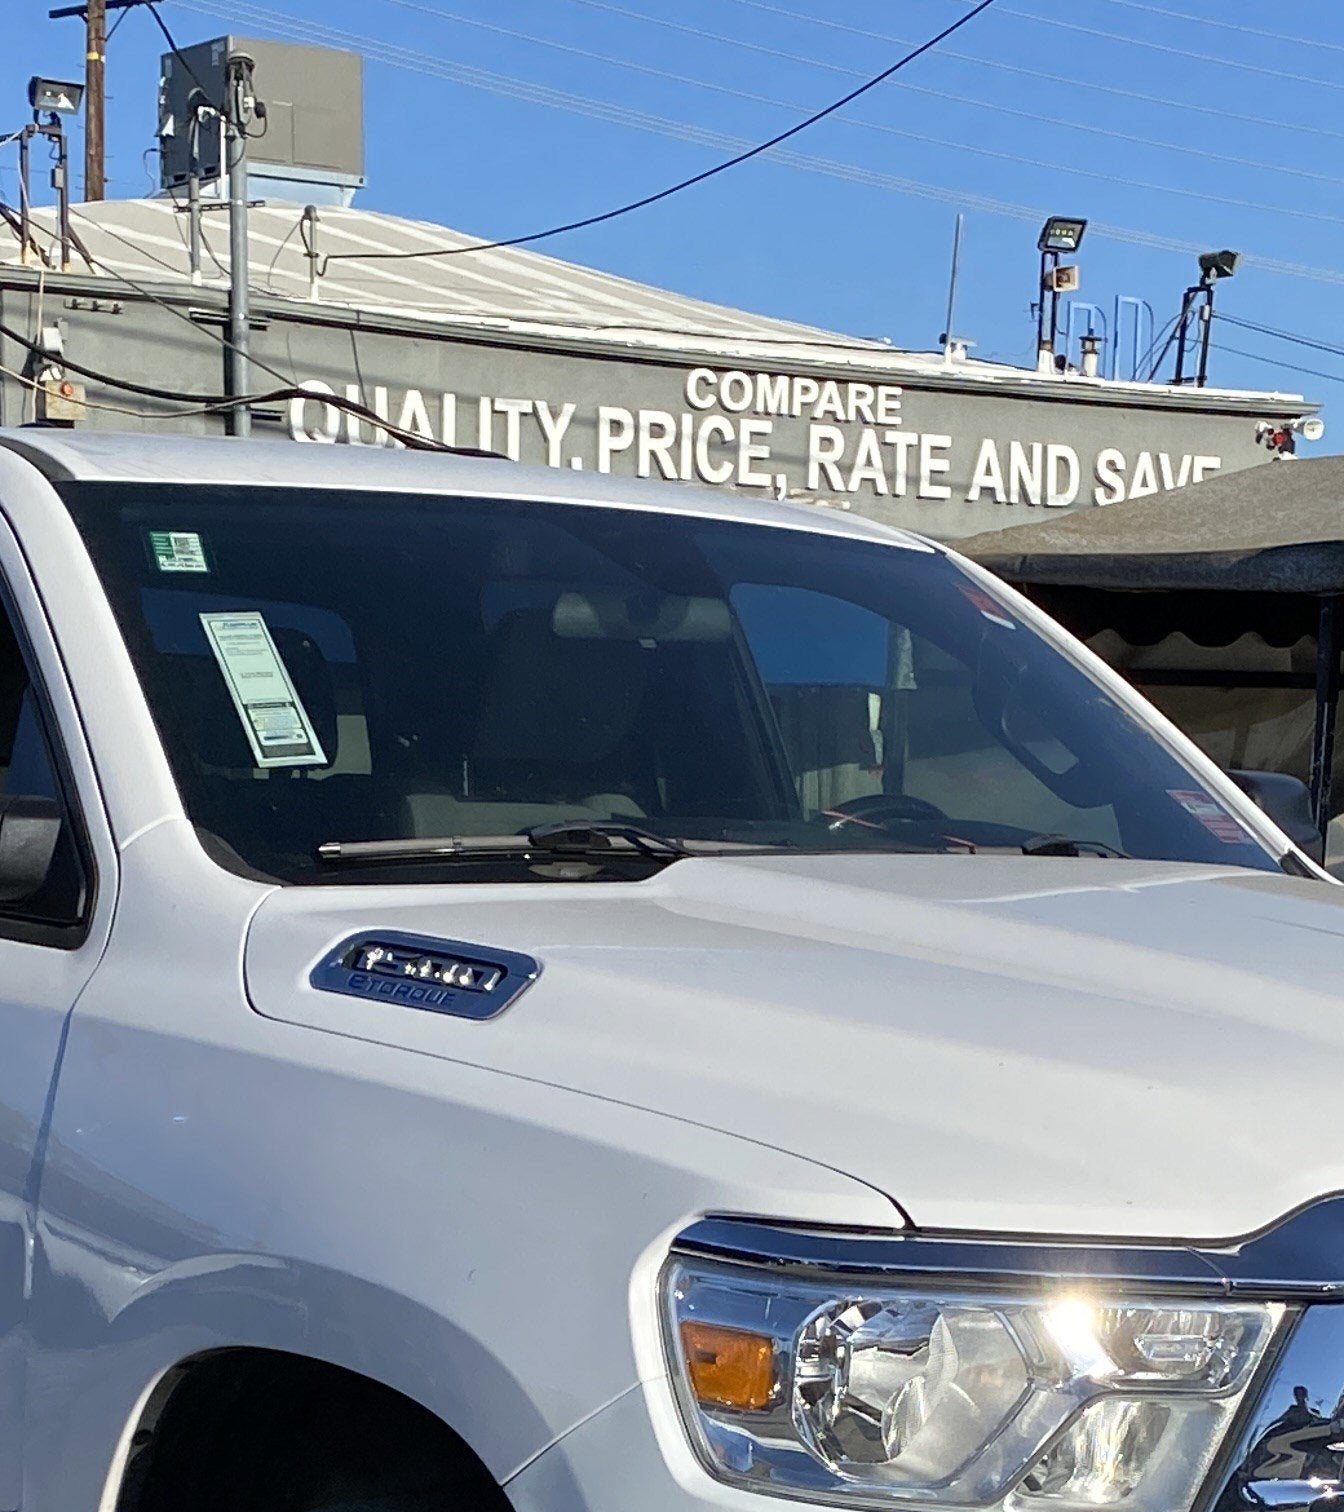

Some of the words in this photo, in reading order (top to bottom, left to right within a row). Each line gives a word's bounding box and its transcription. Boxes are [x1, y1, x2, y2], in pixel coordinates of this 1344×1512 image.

[685, 367, 903, 426] COMPARE
[598, 405, 787, 501] PRICE,
[808, 424, 952, 500] RATE
[967, 438, 1081, 507] AND
